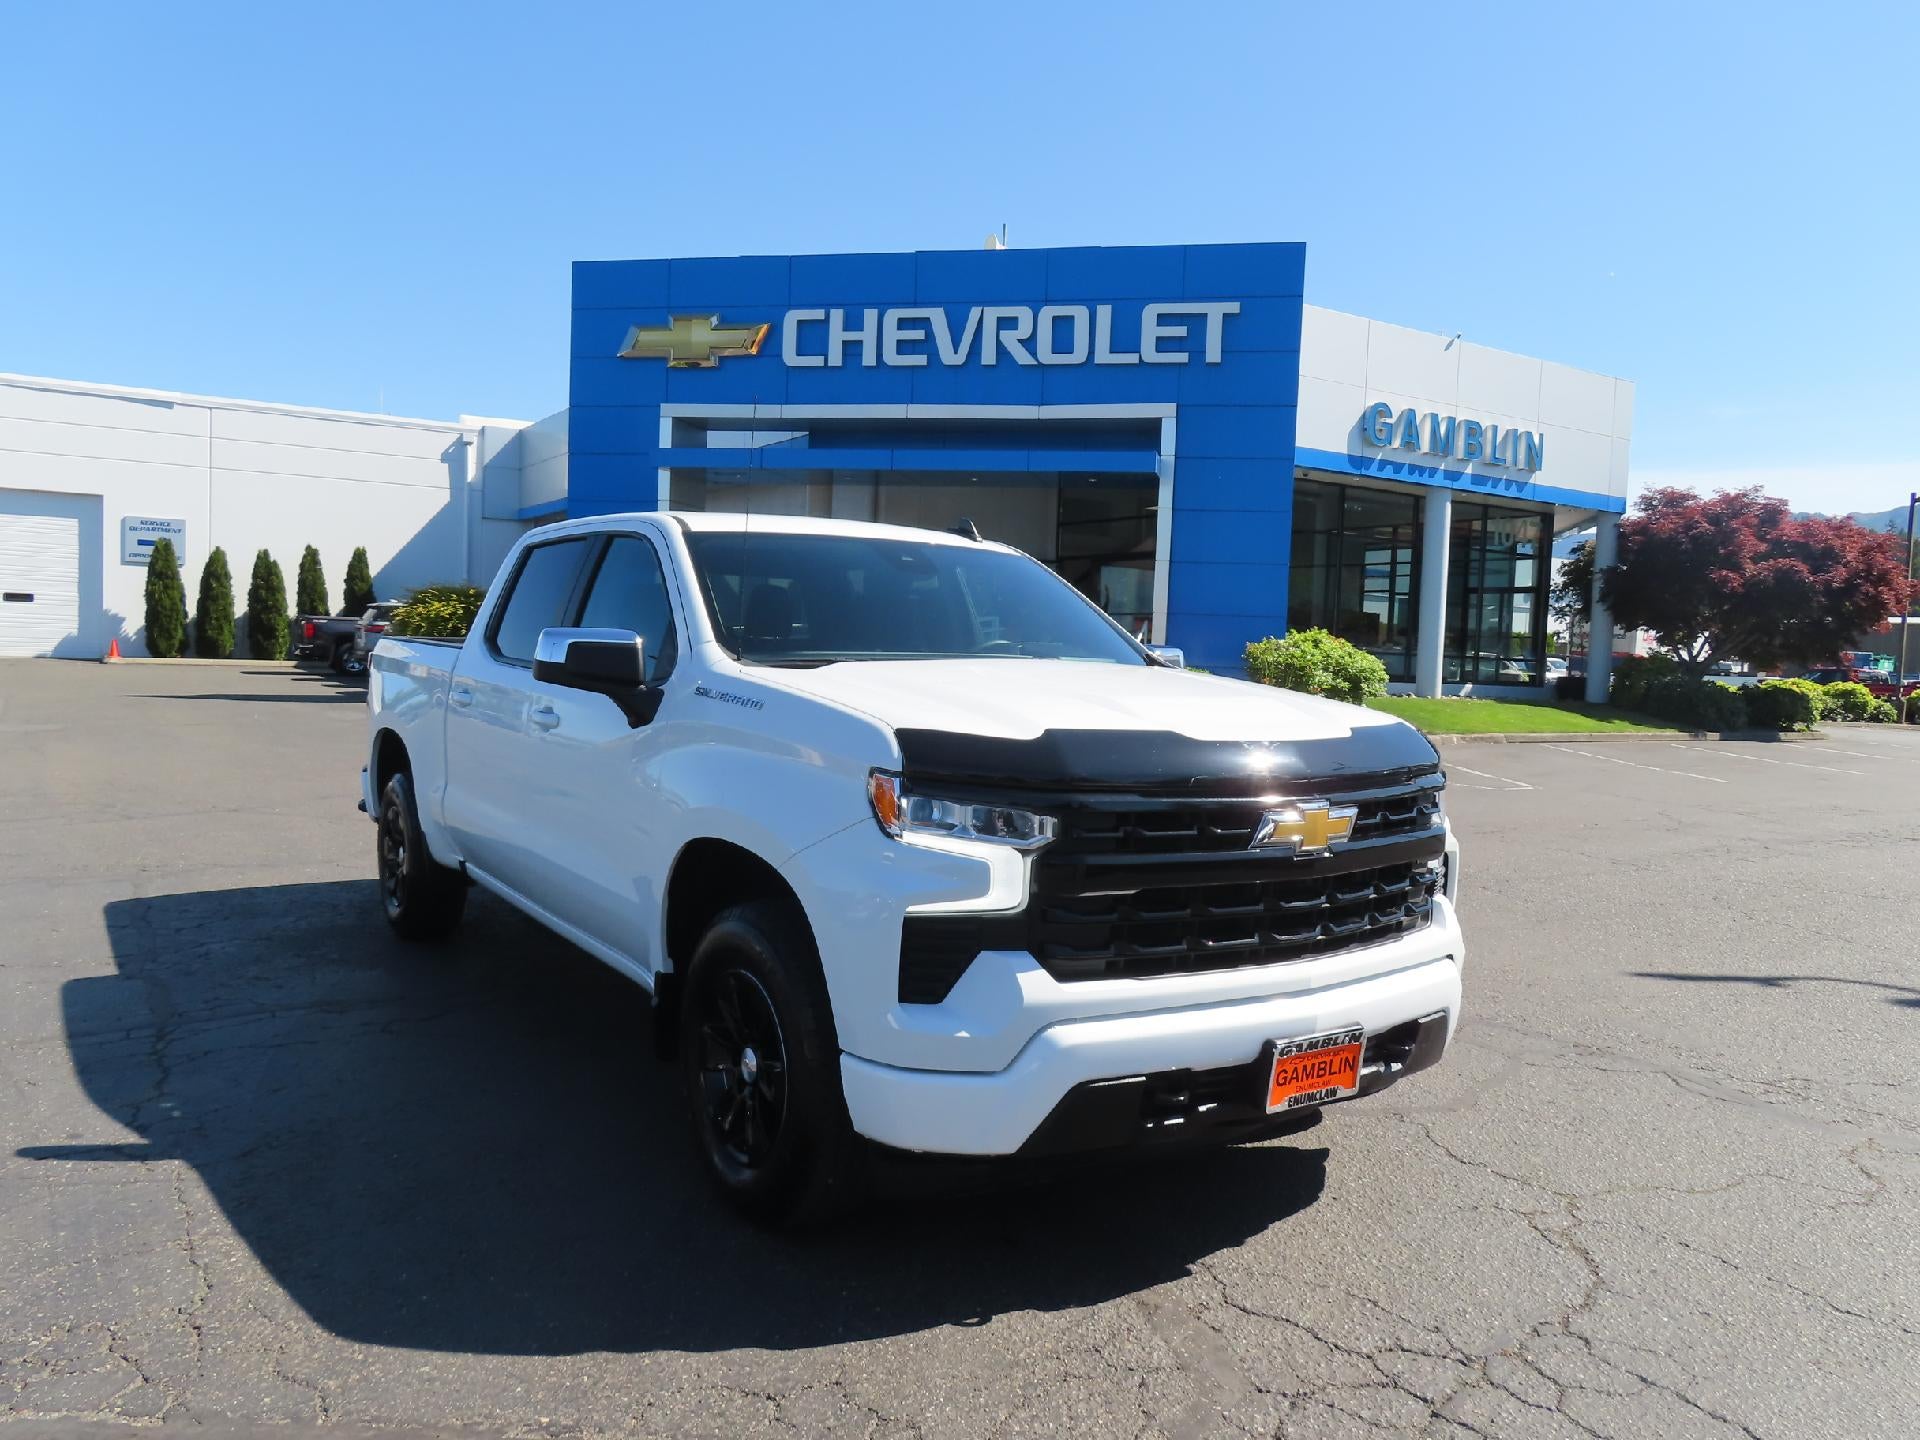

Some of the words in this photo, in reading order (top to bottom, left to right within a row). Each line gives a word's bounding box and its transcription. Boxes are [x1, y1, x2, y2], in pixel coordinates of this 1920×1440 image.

[782, 302, 1240, 366] CHEVROLET
[1363, 401, 1544, 472] GAMBLIN
[128, 526, 182, 534] DEPARTMENT
[694, 686, 764, 710] SILVERADO
[1275, 1055, 1356, 1087] GAMBLIN
[1287, 1086, 1339, 1109] ENUMCLAW
